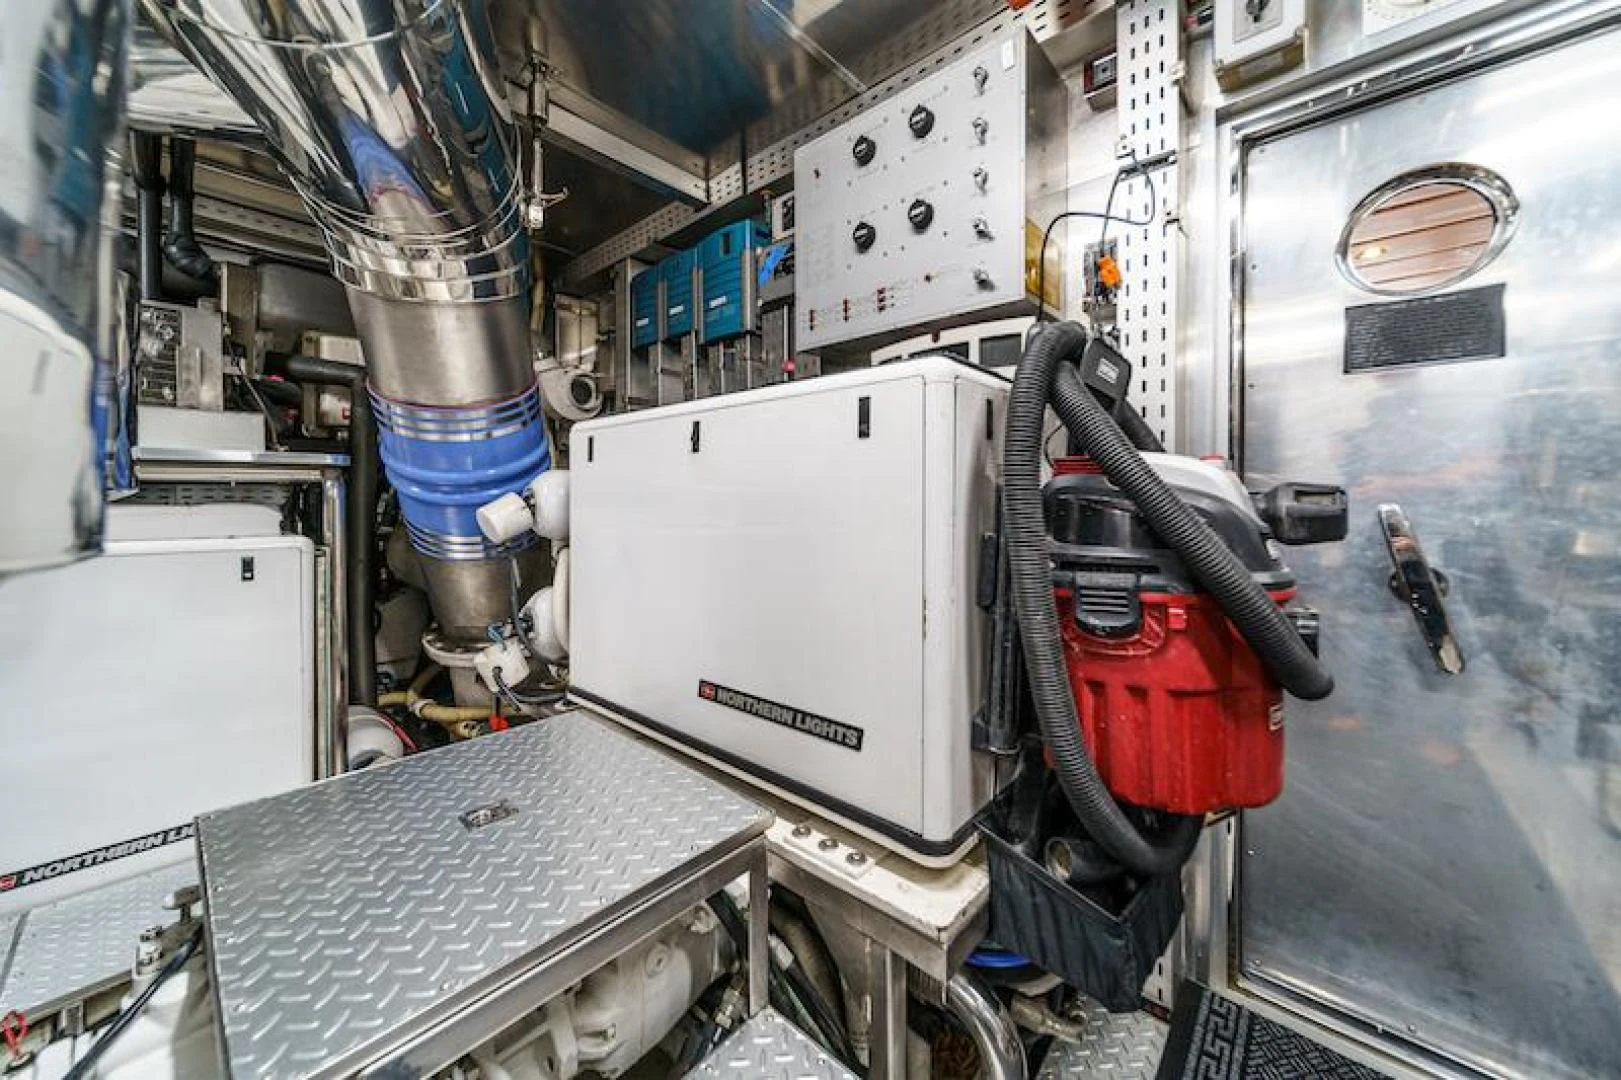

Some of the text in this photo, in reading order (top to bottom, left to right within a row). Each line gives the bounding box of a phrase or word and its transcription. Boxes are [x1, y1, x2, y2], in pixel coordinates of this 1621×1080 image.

[716, 687, 858, 747] NORTHERN LIGHTS
[22, 833, 164, 884] NORTHERN
